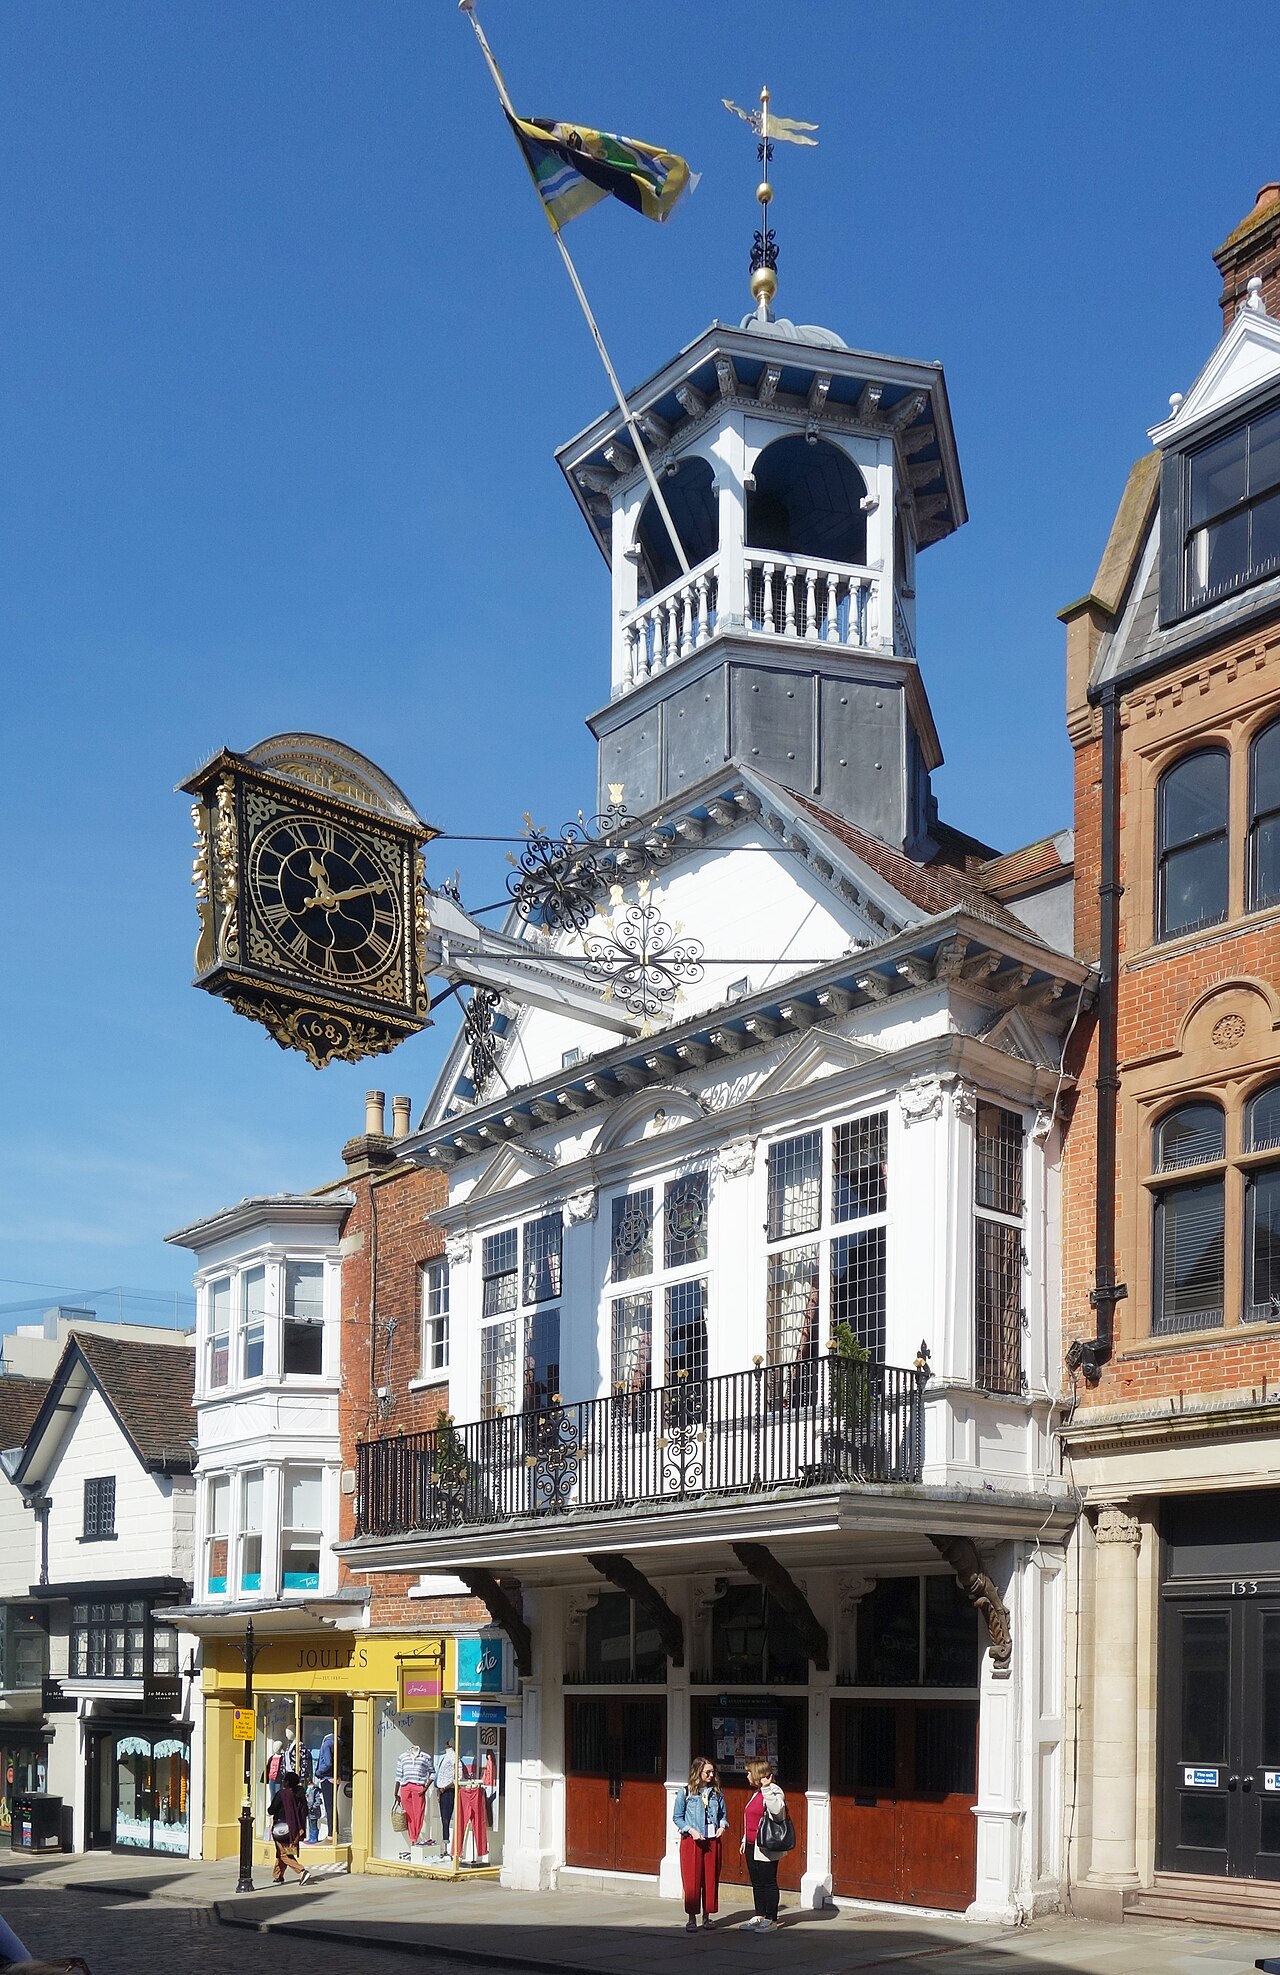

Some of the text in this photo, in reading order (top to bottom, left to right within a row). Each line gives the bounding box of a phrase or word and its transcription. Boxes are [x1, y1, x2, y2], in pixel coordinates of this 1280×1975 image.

[302, 1020, 343, 1045] 1683
[1231, 1581, 1258, 1595] 133
[296, 1649, 368, 1668] JOULES
